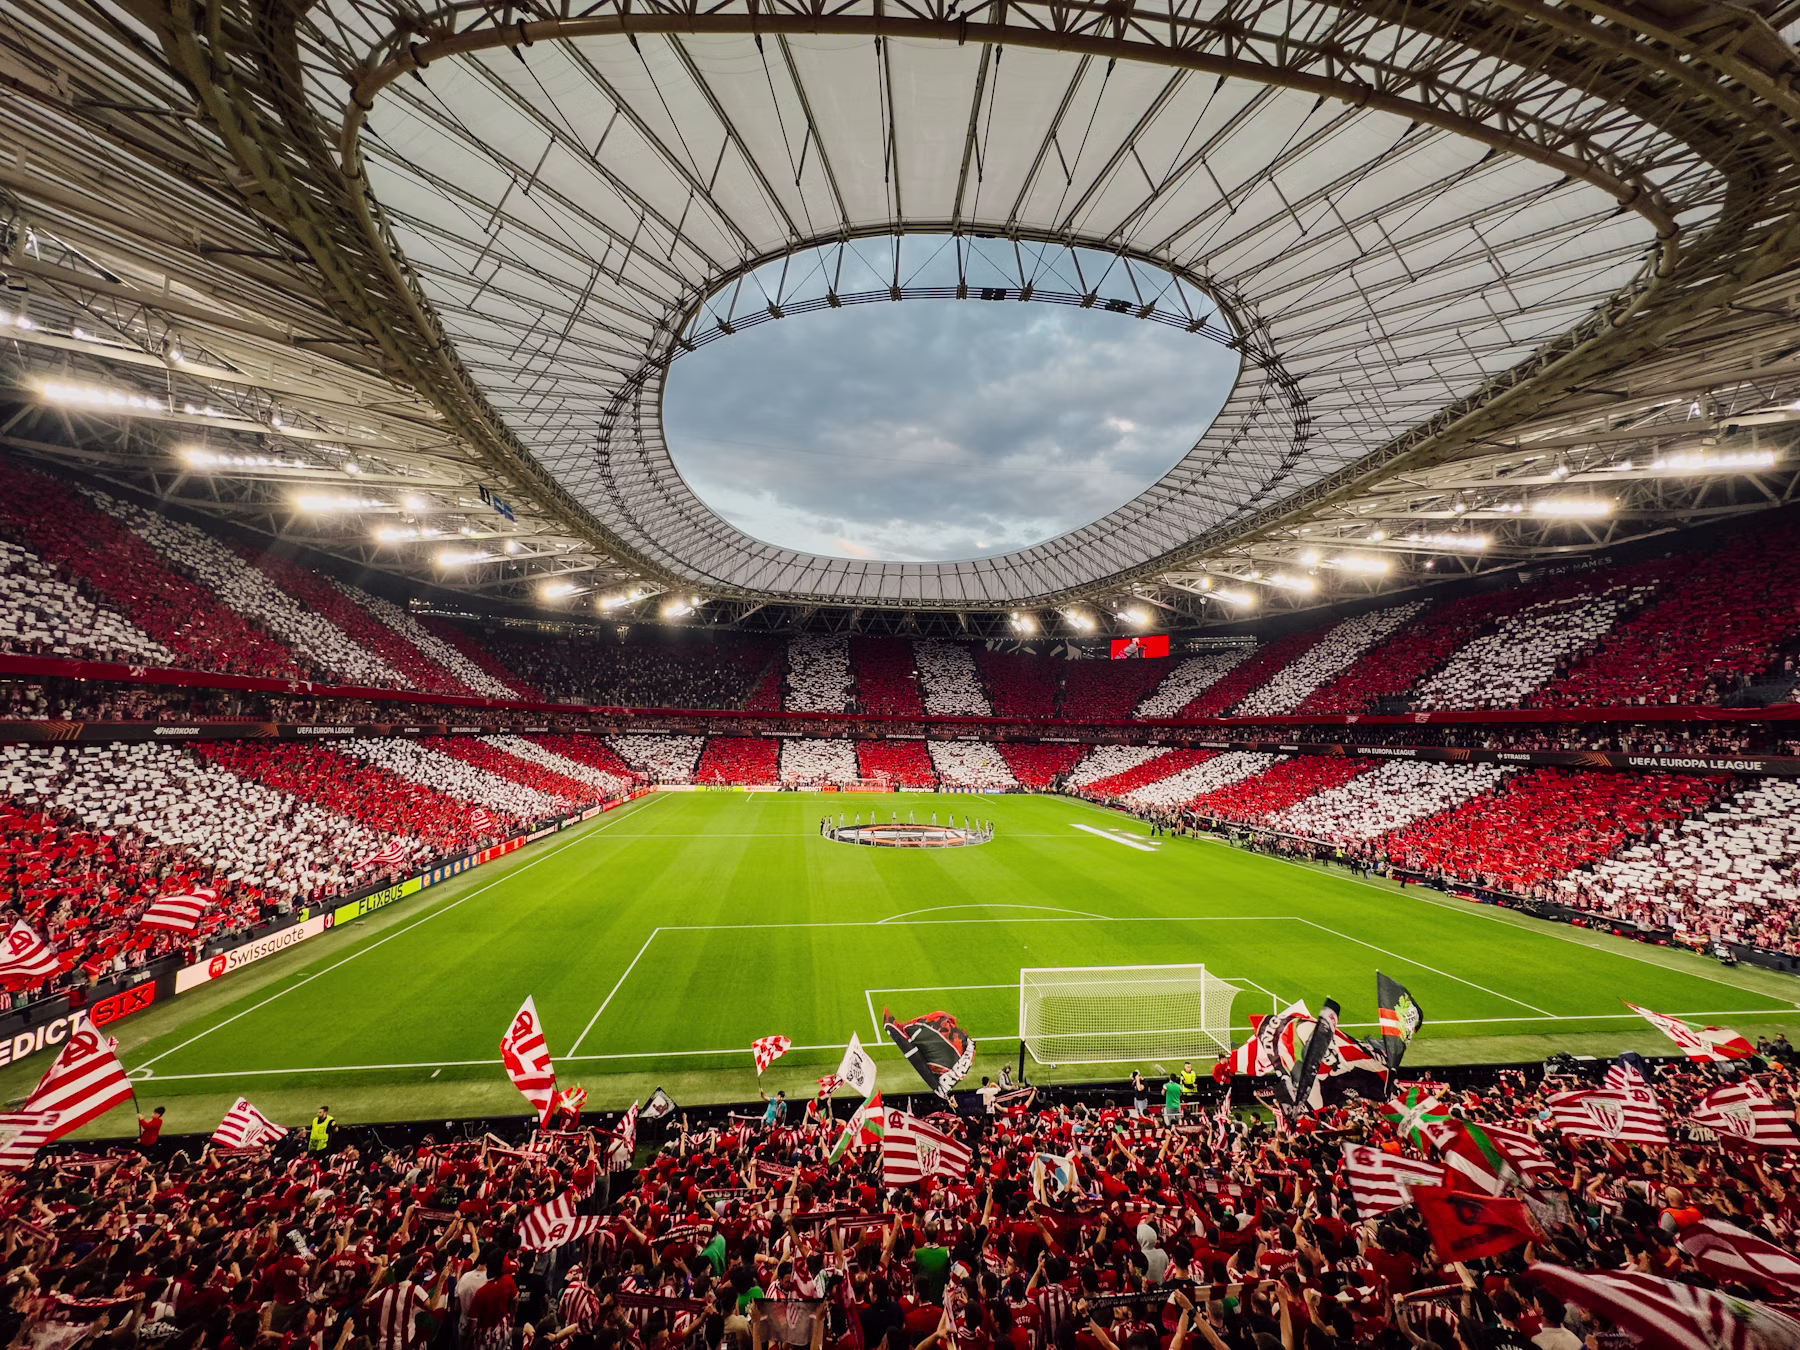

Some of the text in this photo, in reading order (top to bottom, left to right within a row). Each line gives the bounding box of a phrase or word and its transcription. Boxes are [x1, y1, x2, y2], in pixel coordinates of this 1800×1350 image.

[1629, 757, 1658, 766] UEFA
[1660, 757, 1708, 769] EUROPA
[228, 927, 304, 969] Swissquote
[95, 988, 149, 1023] SIX
